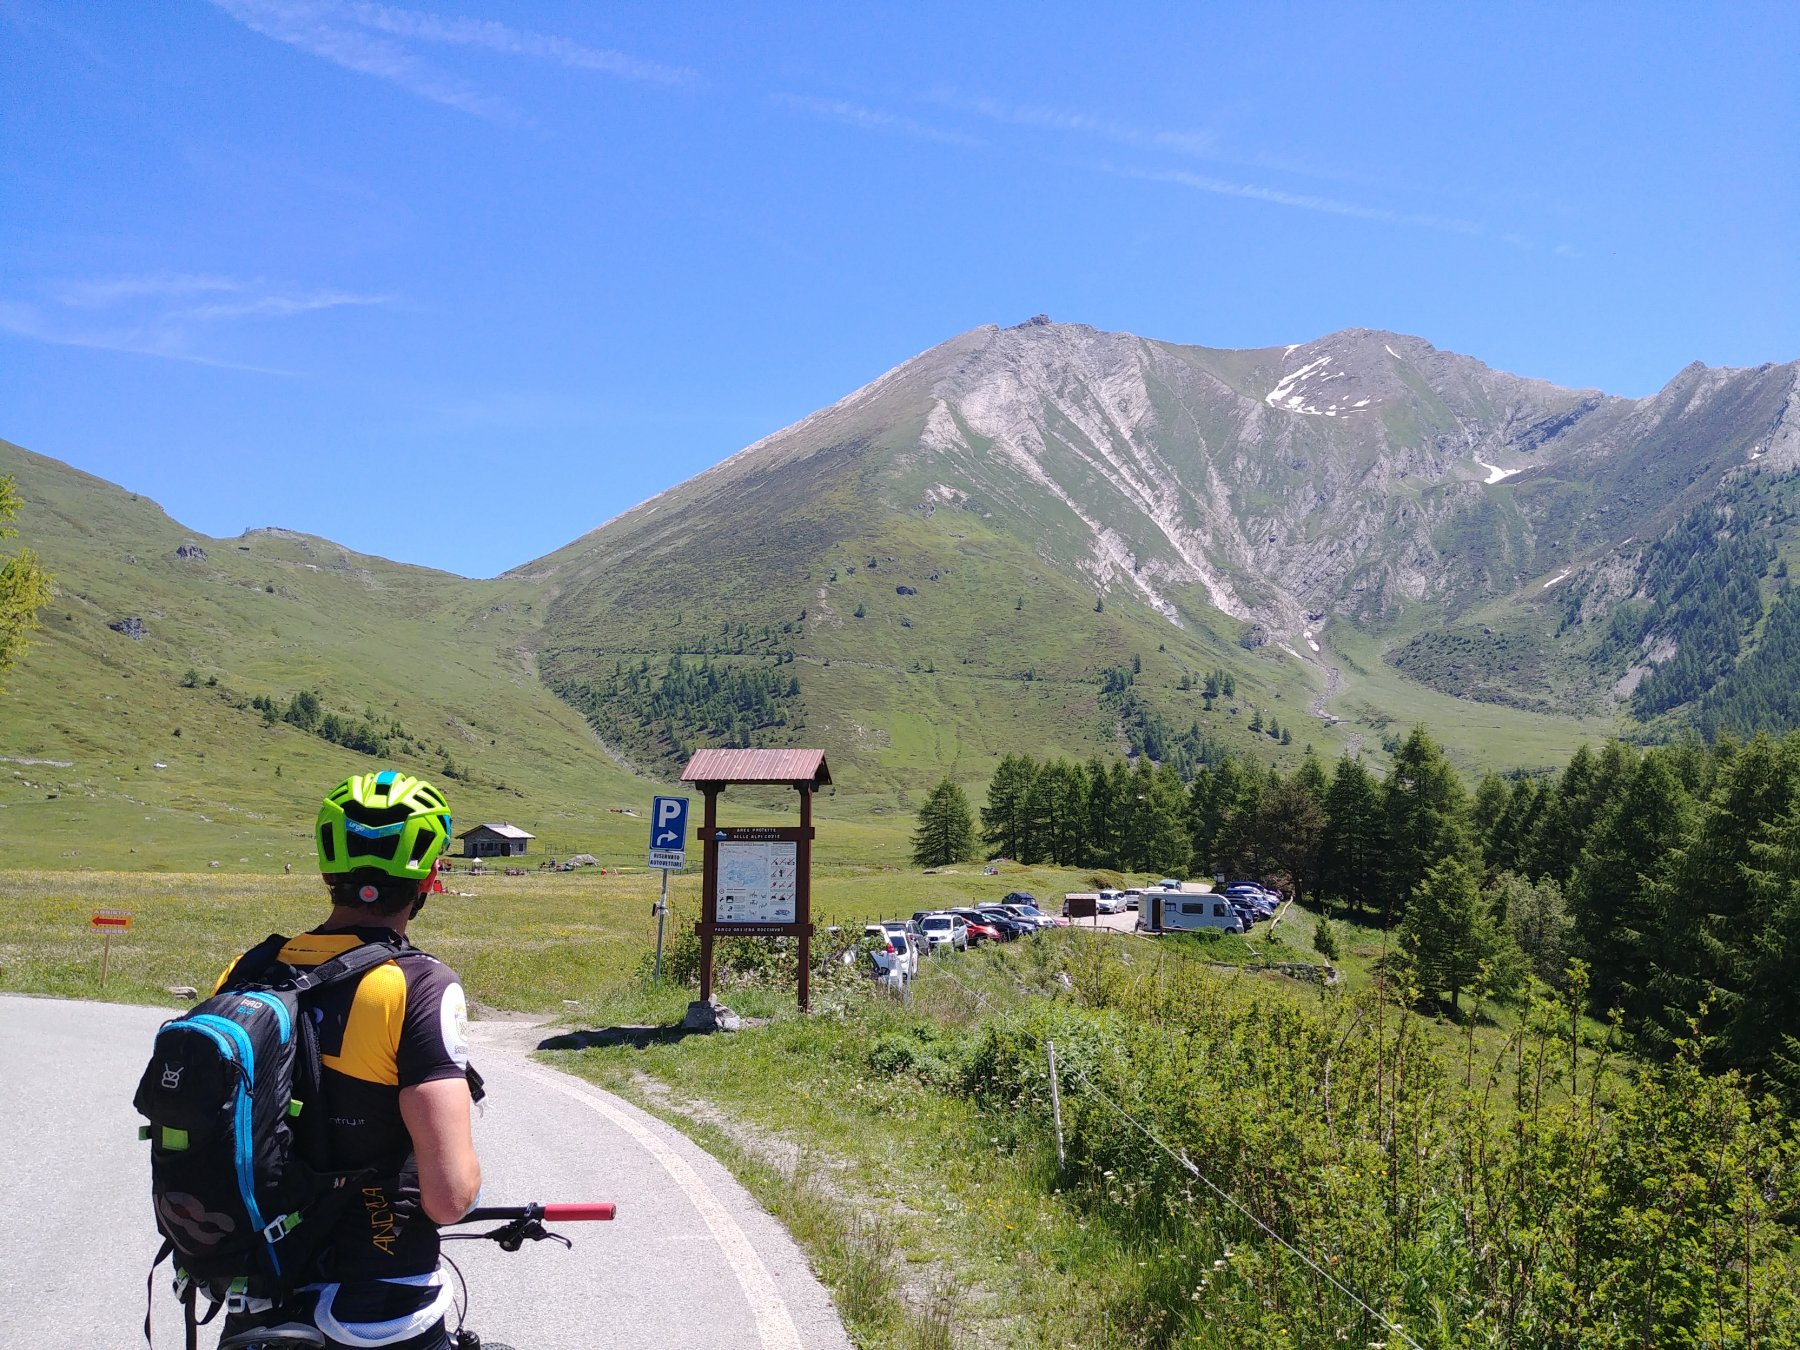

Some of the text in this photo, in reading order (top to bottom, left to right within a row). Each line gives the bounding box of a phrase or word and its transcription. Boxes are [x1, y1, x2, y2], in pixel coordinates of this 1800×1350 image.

[658, 799, 681, 828] P
[349, 822, 366, 832] urge
[653, 852, 680, 860] RISERVATO
[650, 859, 682, 868] AUTOVETTURE
